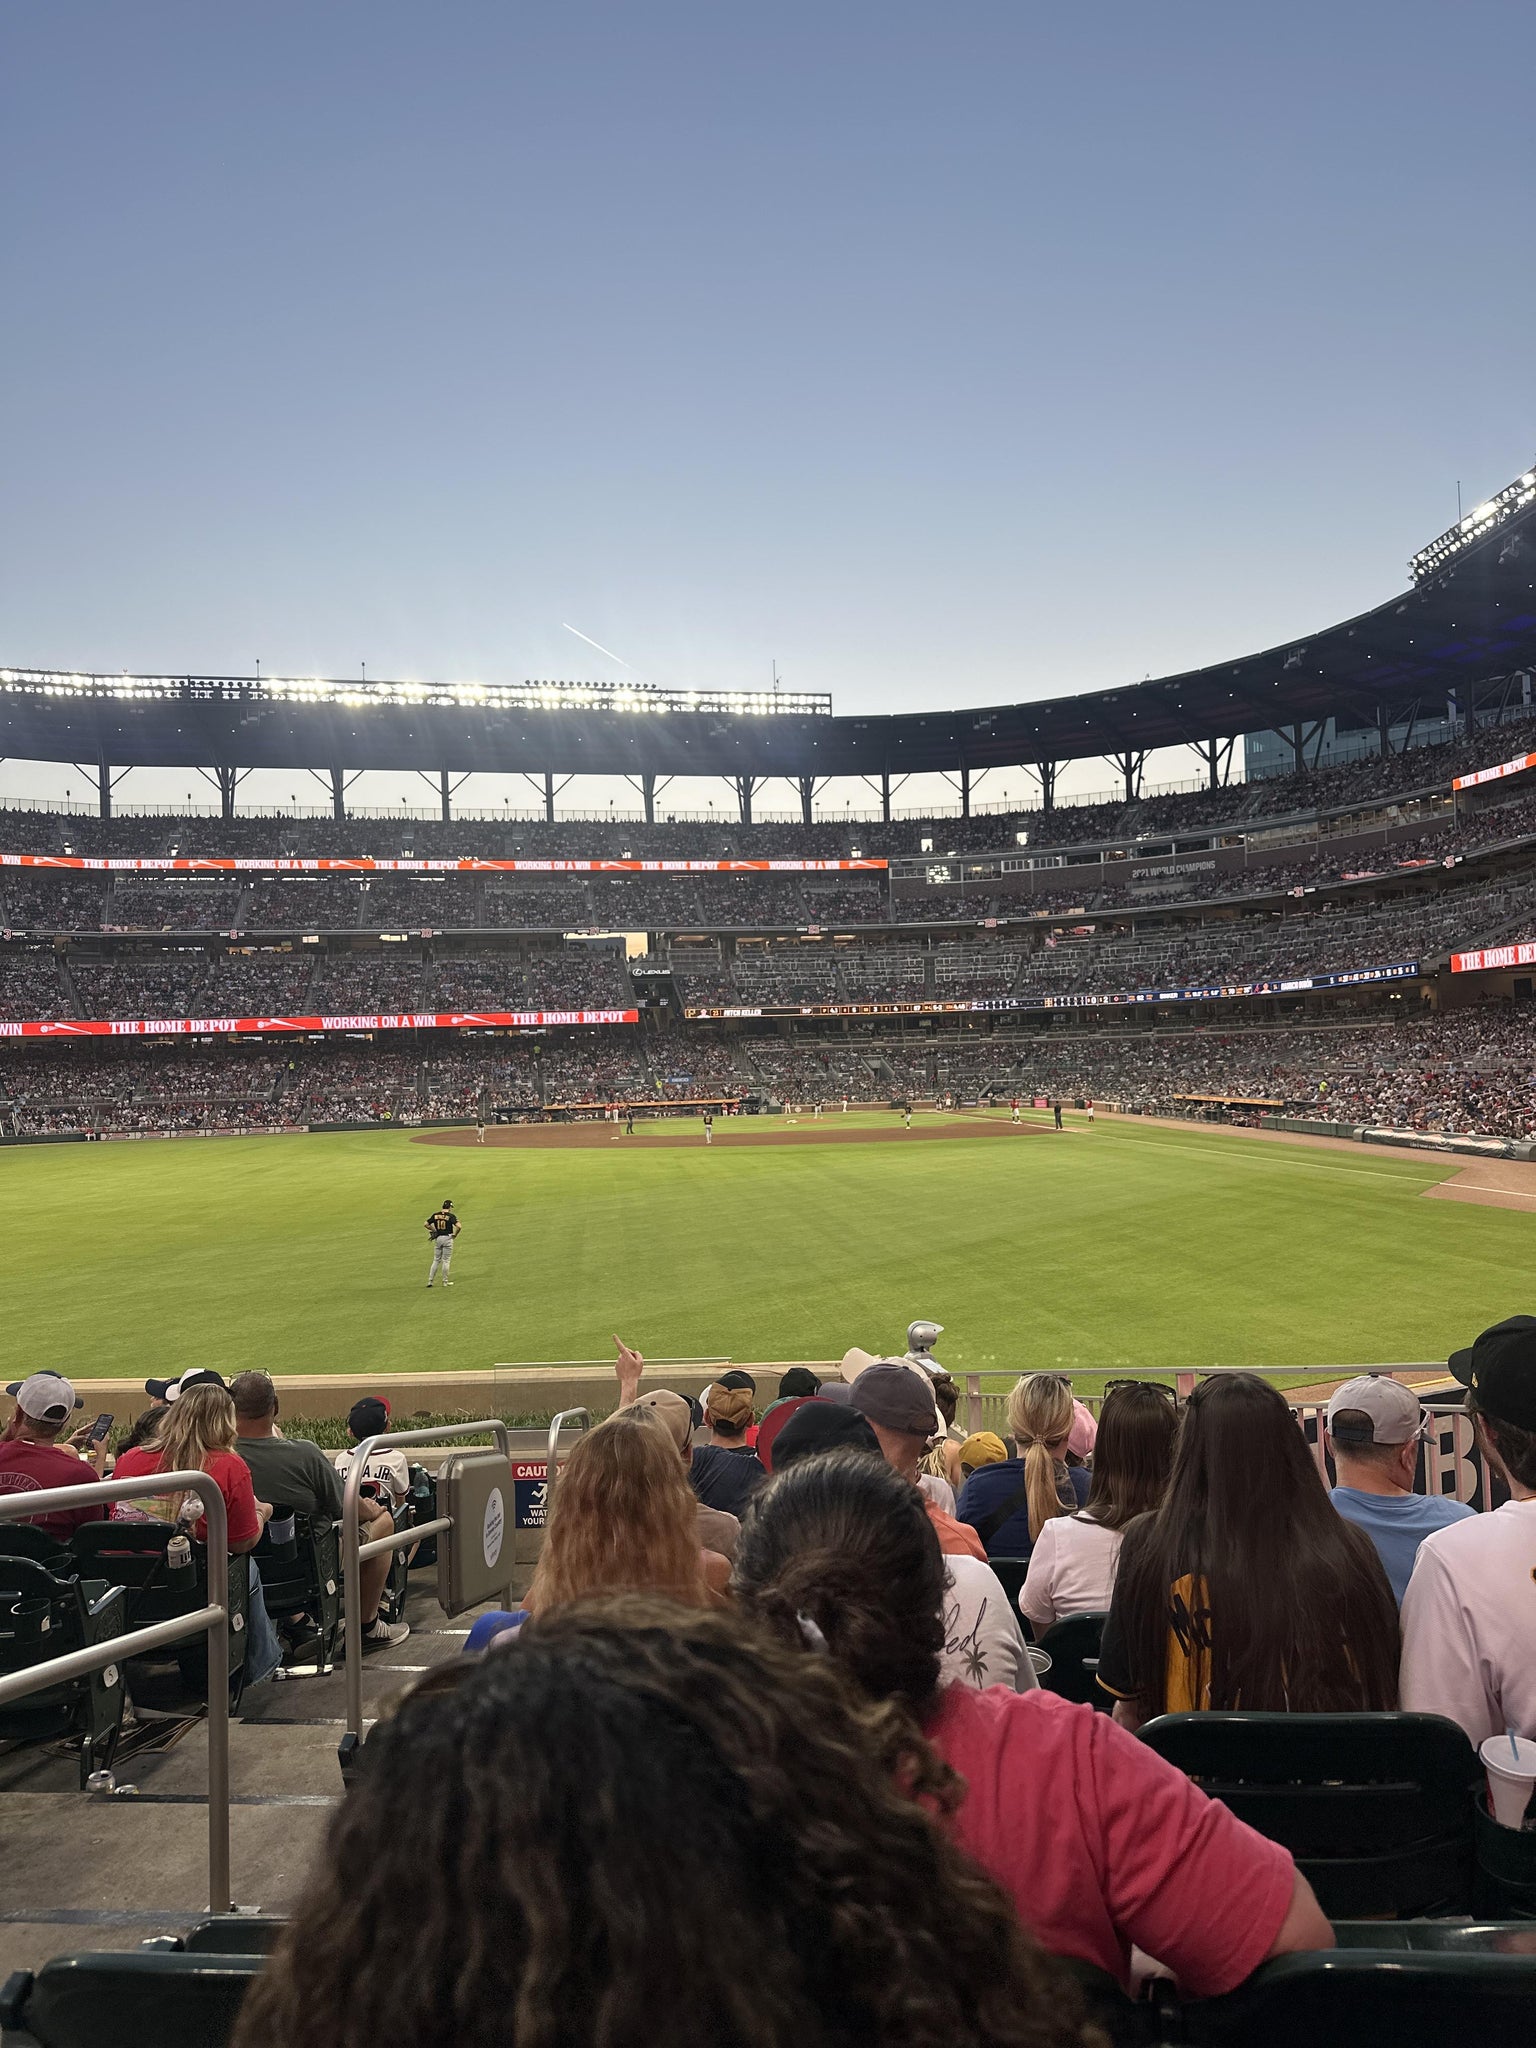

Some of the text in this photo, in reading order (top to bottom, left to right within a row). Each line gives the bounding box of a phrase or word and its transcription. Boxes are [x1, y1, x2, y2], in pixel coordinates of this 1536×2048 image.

[1478, 766, 1502, 783] HOME
[1503, 756, 1527, 776] DEPOT
[1, 855, 20, 865] WIN
[82, 859, 174, 869] THE HOME DEPOT
[235, 860, 318, 869] WORKING ON A WIN
[375, 860, 459, 870] THE HOME DEPOT
[769, 860, 840, 870] WORKING ON A WIN
[515, 861, 591, 870] WORKING ON A WIN
[641, 861, 718, 870] THE HOME DEPOT
[1176, 860, 1216, 874] CHAMPIONS
[1460, 951, 1480, 972] THE
[1483, 945, 1515, 969] HOME
[322, 1015, 436, 1029] WORKING ON A WIN
[511, 1011, 625, 1025] THE HOME DEPOT
[0, 1023, 22, 1036] WIN
[109, 1019, 238, 1034] THE HOME DEPOT
[437, 1220, 446, 1230] 10
[374, 1466, 390, 1481] JR.
[530, 1509, 548, 1517] WAT
[522, 1517, 545, 1525] YOUR
